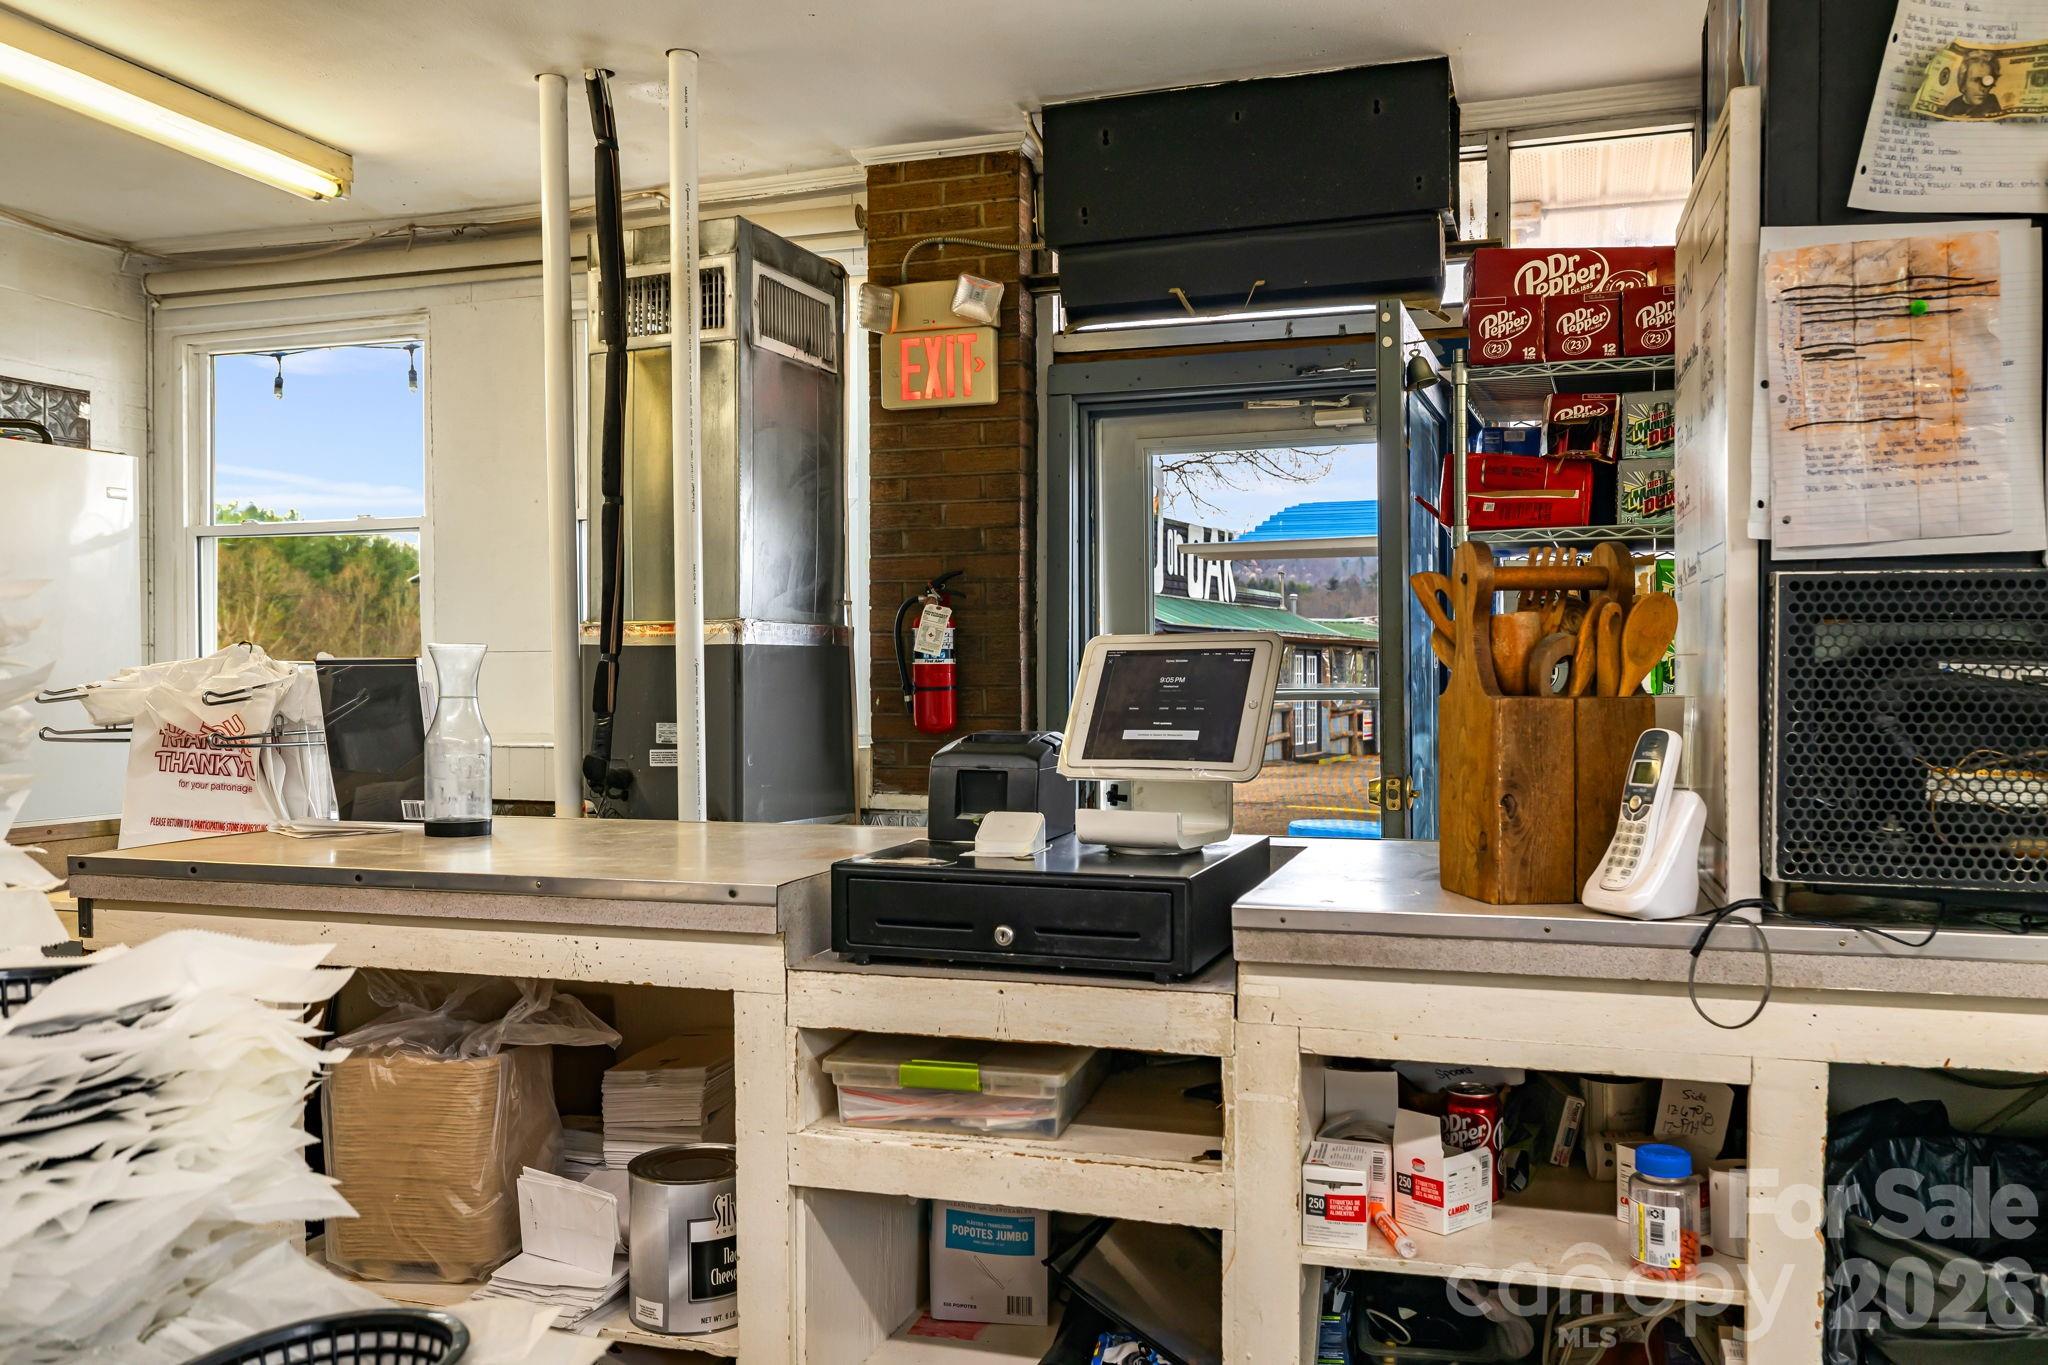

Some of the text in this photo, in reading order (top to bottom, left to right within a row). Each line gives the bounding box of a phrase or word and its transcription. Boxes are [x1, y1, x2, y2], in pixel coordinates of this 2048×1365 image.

[1547, 253, 1580, 275] Dr
[1514, 260, 1602, 297] Pepper
[1575, 308, 1595, 322] Dr
[1654, 300, 1674, 317] Dr
[1498, 310, 1516, 324] Dr
[1556, 313, 1606, 336] Pepper
[1479, 315, 1528, 340] Pepper
[1570, 340, 1582, 350] 23
[1650, 334, 1662, 344] 23
[1491, 344, 1502, 354] 23
[1522, 348, 1536, 356] 12
[1602, 344, 1616, 352] 12
[901, 333, 978, 400] EXIT
[1574, 404, 1592, 414] Dr
[155, 751, 231, 776] THANK
[178, 778, 253, 794] for your patronage
[150, 816, 167, 827] PLEASE
[166, 818, 183, 828] RETURN
[184, 820, 190, 828] TO
[194, 820, 225, 831] PARTICIPATING
[225, 822, 240, 832] STORE
[1449, 1114, 1471, 1131] Dr
[1399, 1176, 1411, 1188] 250
[1308, 1197, 1324, 1209] 250
[1448, 1204, 1470, 1216] CAMBRO
[952, 1224, 1028, 1242] POPOTES JUMBO
[711, 1268, 738, 1286] Cheese
[701, 1316, 712, 1325] NET
[714, 1314, 724, 1324] WT.
